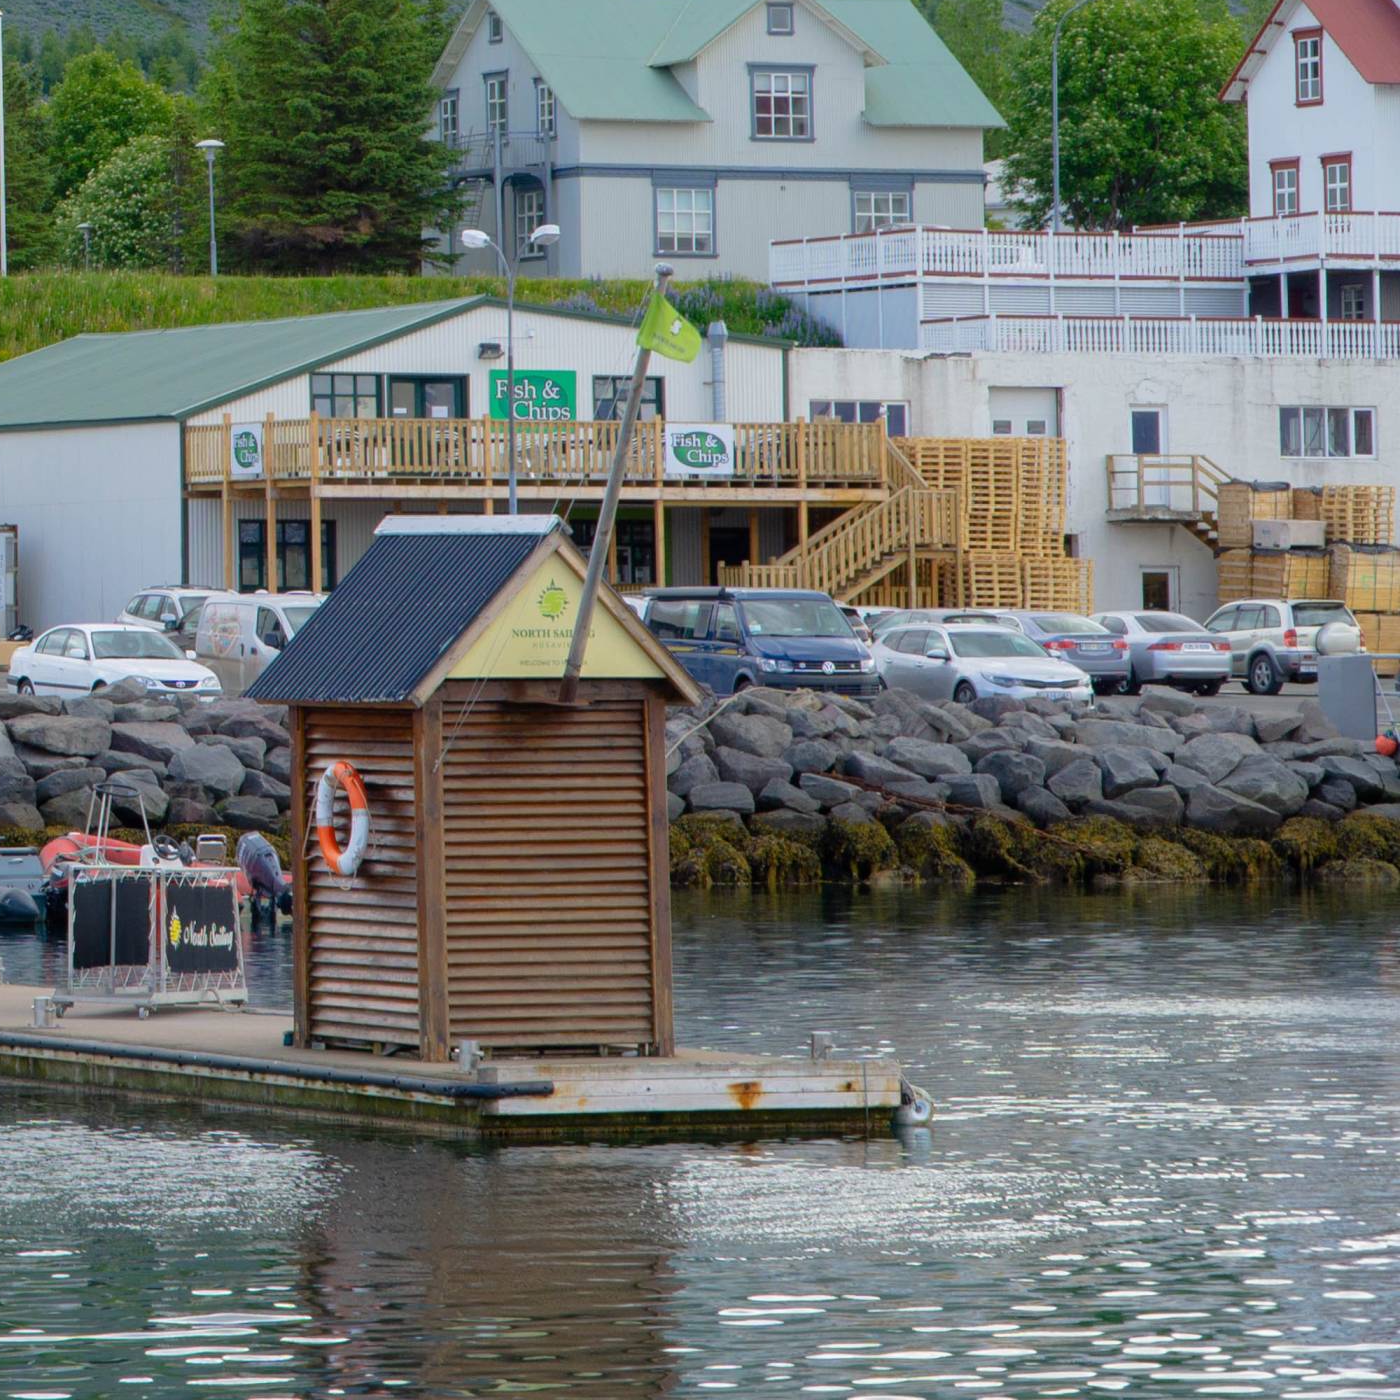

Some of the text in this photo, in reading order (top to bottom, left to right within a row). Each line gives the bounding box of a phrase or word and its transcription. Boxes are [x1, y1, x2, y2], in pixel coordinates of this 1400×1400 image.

[495, 379, 561, 399] Fsh &
[512, 400, 571, 420] Chips
[671, 433, 719, 448] Fish &
[687, 449, 729, 467] Chips
[512, 629, 596, 638] NORTH SAILG
